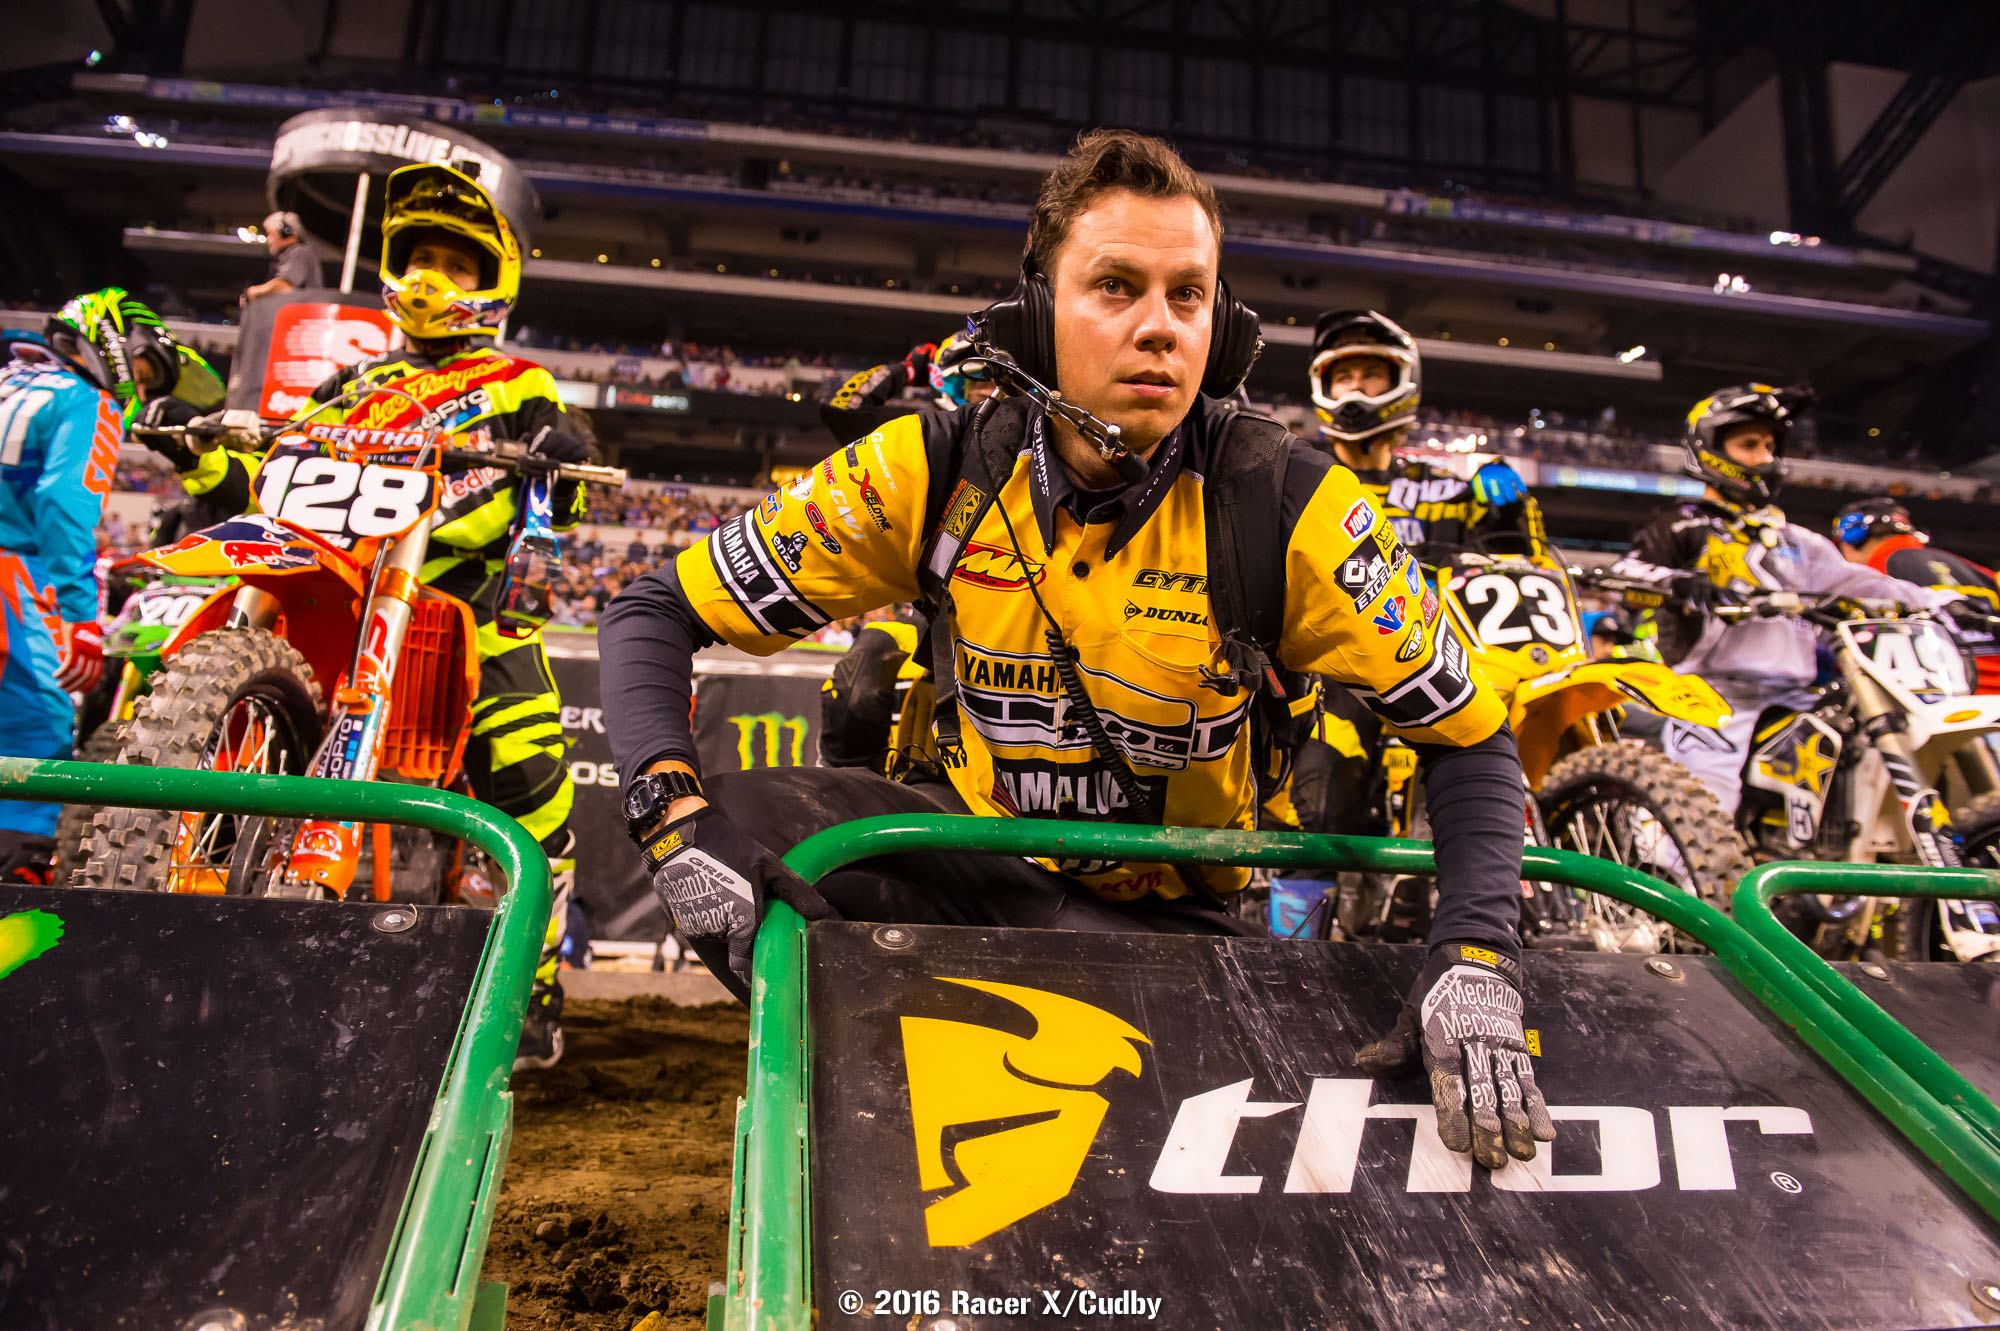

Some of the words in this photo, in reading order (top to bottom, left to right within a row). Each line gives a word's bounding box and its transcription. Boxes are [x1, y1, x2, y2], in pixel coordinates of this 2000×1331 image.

[403, 388, 489, 432] oPro
[309, 425, 425, 448] RENTHA
[258, 454, 428, 537] 128
[1347, 503, 1373, 534] 100%
[722, 514, 760, 585] YAMAHA
[773, 535, 798, 571] enzo
[1356, 566, 1392, 610] EXCEL
[1373, 597, 1402, 631] VP
[1464, 574, 1576, 647] 23
[962, 651, 1068, 694] YAMAH
[1872, 632, 1971, 696] 49
[688, 856, 736, 885] GRIP
[1428, 972, 1456, 1008] GRIP
[1149, 1077, 1814, 1194] thor
